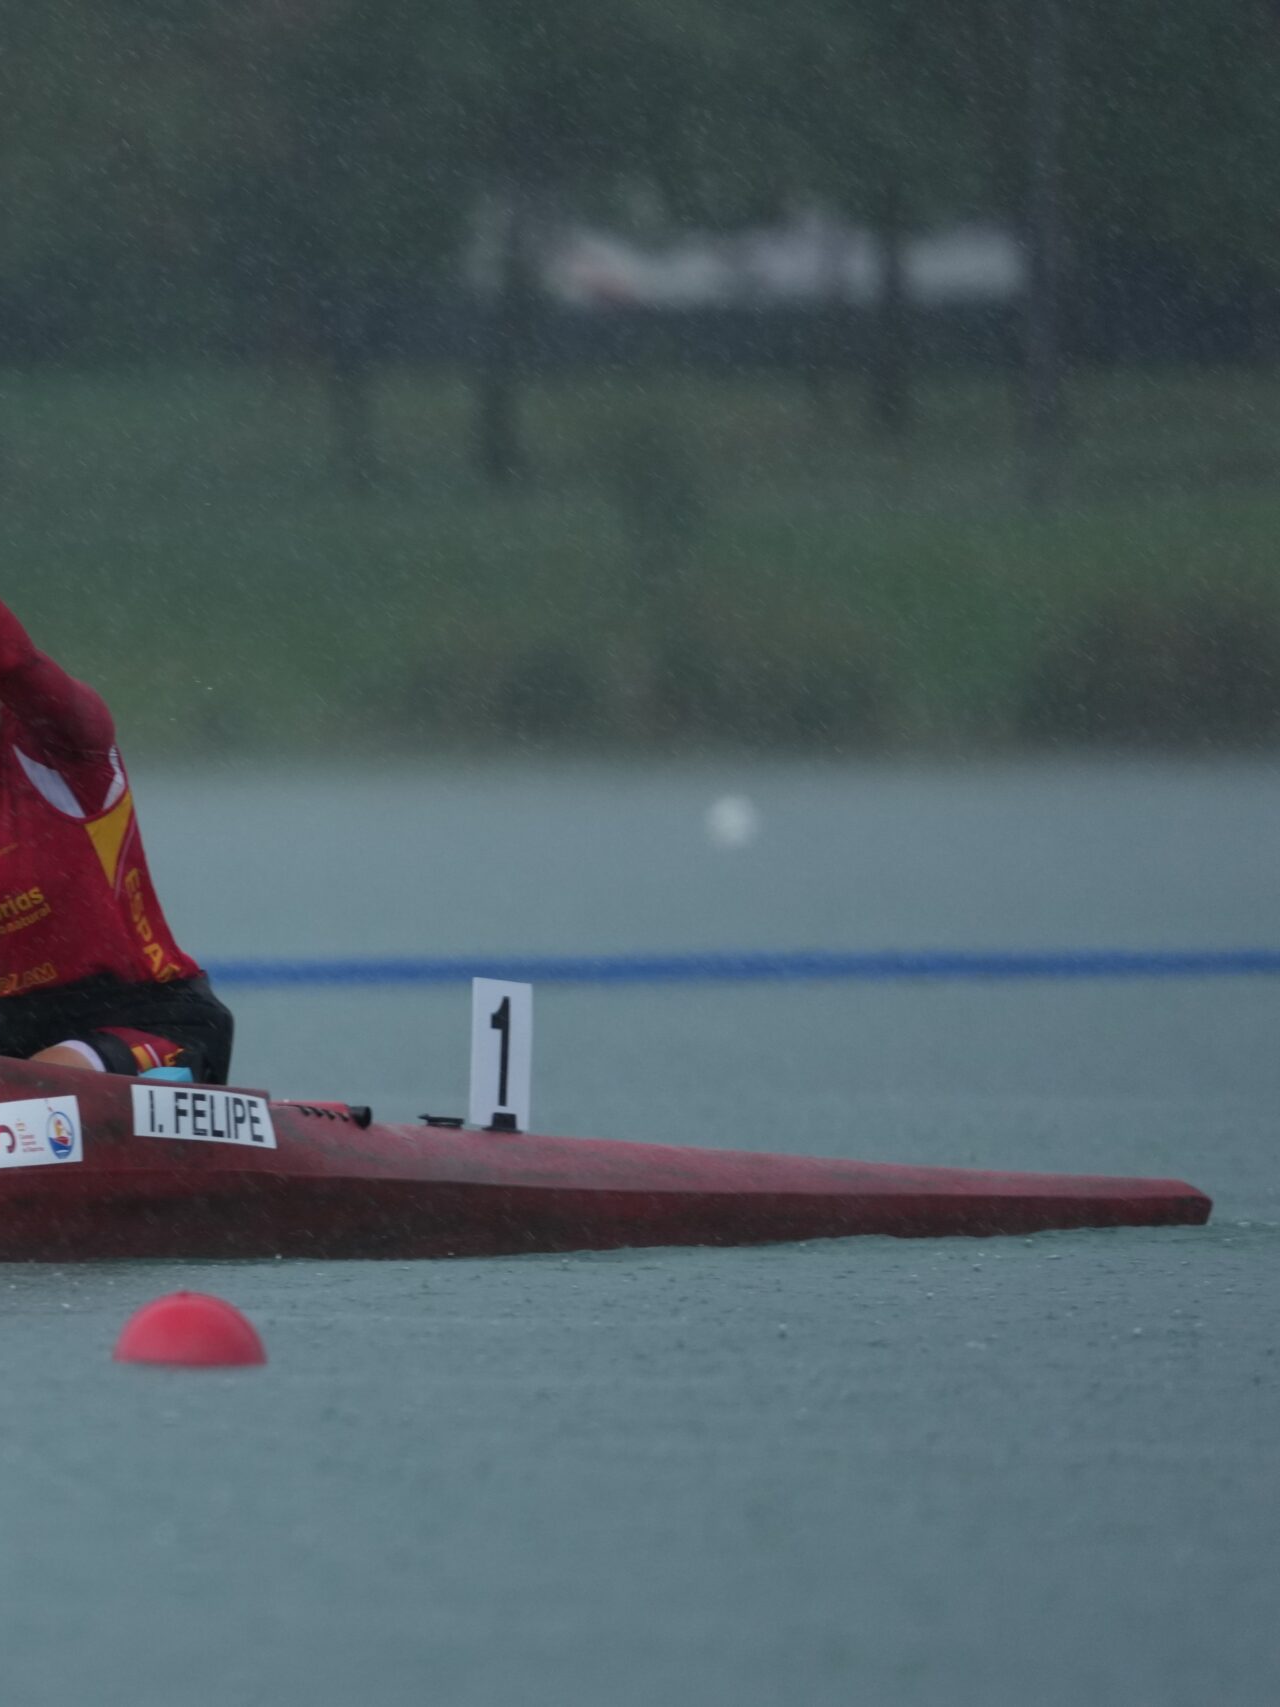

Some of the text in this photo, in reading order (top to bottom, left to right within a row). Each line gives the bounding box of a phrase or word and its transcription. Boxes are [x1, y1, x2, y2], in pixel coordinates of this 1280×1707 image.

[490, 996, 510, 1106] 1
[148, 1090, 264, 1143] I. FELIPE
